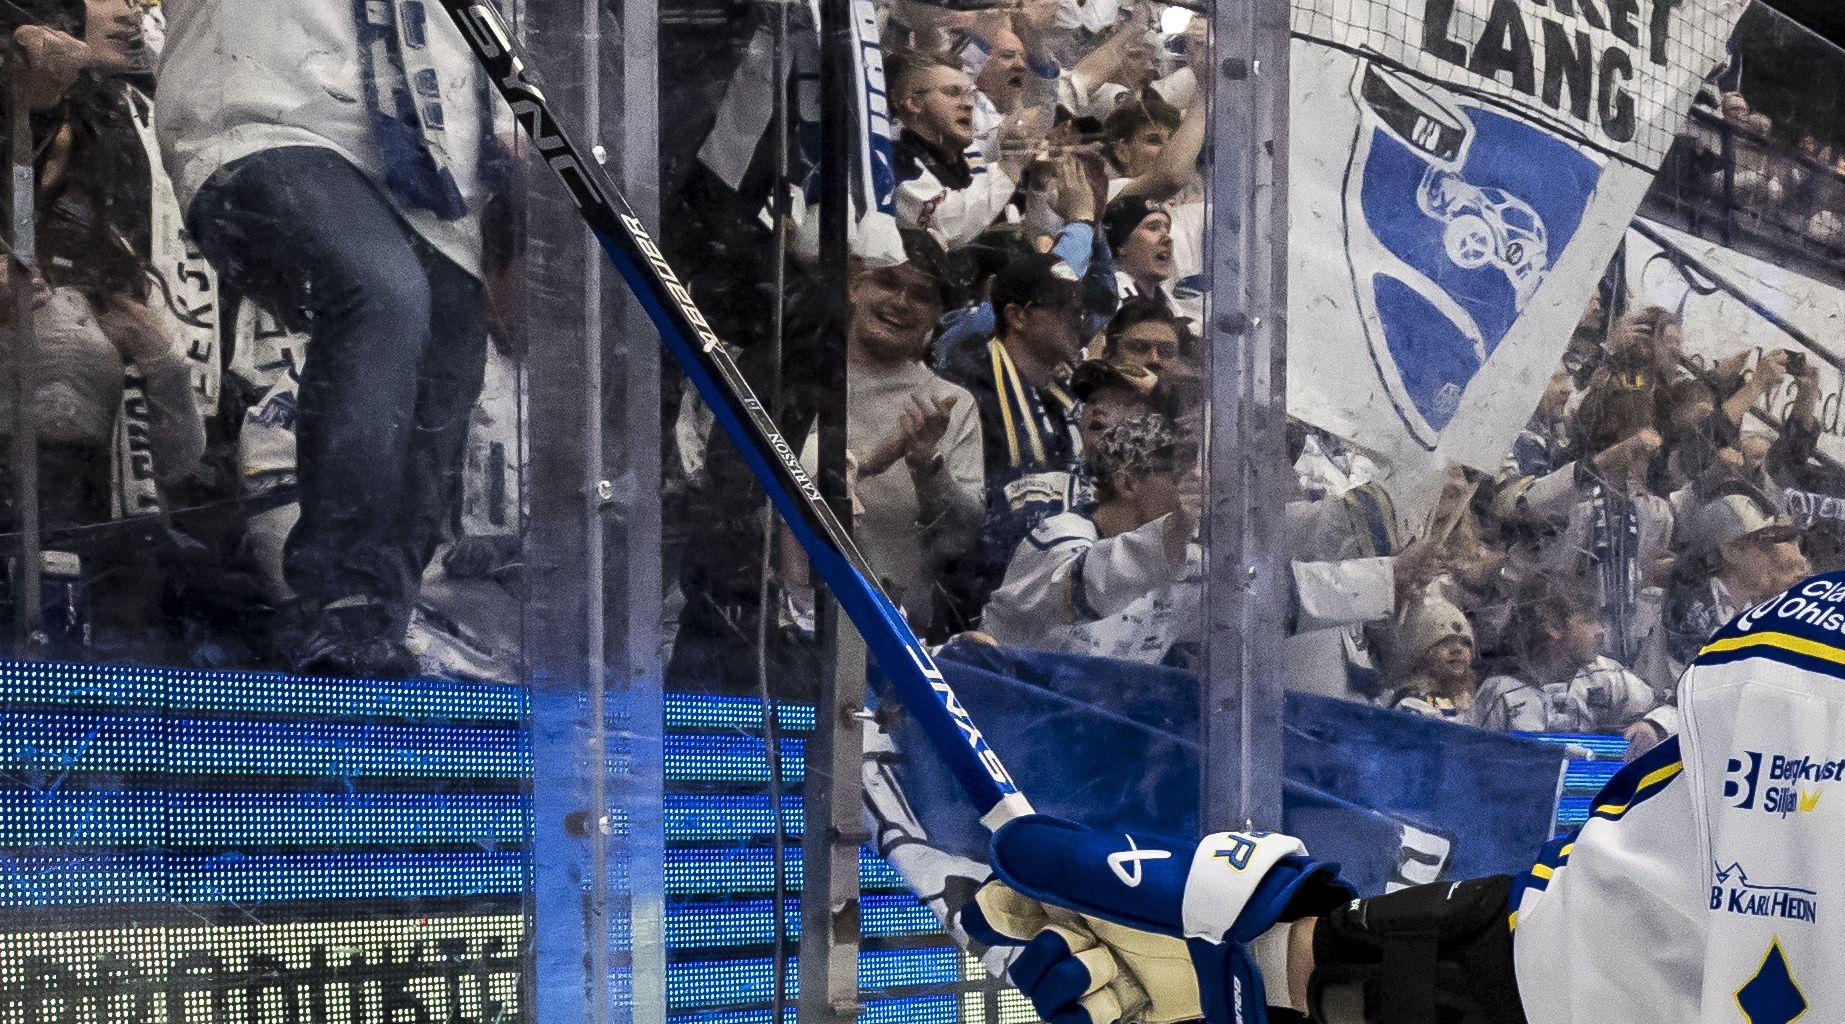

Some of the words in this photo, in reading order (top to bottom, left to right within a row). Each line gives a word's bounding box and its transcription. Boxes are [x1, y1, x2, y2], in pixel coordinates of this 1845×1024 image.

[457, 4, 602, 208] SYNC
[1421, 0, 1636, 143] LANG
[766, 432, 822, 501] KARLSSON
[906, 644, 1014, 783] SYNC
[1709, 885, 1724, 910] B
